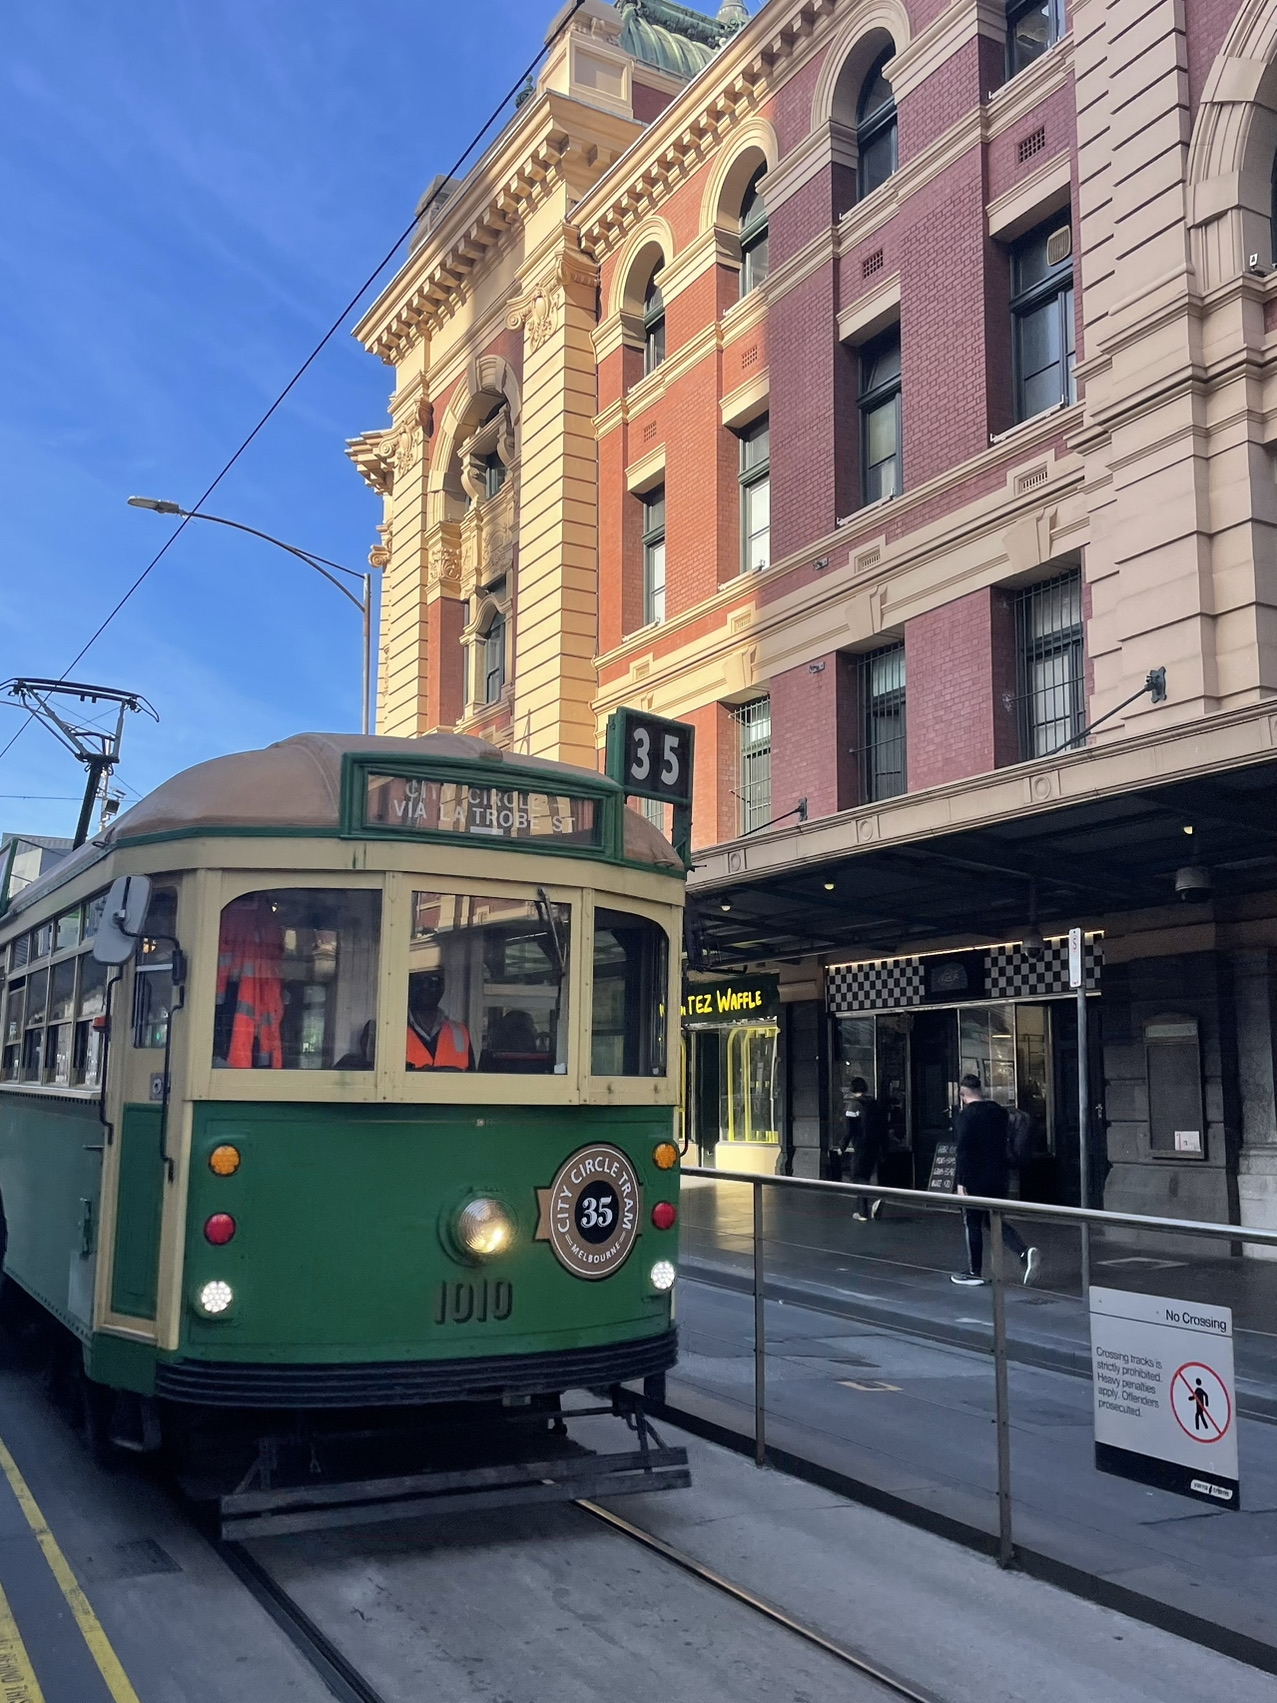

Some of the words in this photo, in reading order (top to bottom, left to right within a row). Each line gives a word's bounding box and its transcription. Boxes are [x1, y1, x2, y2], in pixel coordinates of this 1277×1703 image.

[393, 799, 427, 820] VIA
[440, 803, 465, 823] LA
[472, 807, 539, 830] TROBE
[552, 815, 576, 832] ST
[716, 987, 762, 1013] WAFFLE
[557, 1185, 573, 1233] CITY
[570, 1156, 620, 1185] CIRCLE
[617, 1171, 635, 1230] TRAM
[580, 1195, 613, 1229] 35
[570, 1241, 621, 1264] MELBOURNE
[434, 1279, 514, 1325] 1010
[1165, 1309, 1180, 1322] No
[1182, 1311, 1227, 1333] Crossing
[1096, 1346, 1129, 1364] Crossing
[1130, 1354, 1154, 1368] tracks
[1155, 1358, 1163, 1370] is
[1096, 1360, 1120, 1375] strictly
[1122, 1366, 1163, 1383] prohibited.
[1097, 1372, 1120, 1388] Heavy
[1122, 1379, 1156, 1394] penalties
[1098, 1386, 1120, 1400] apply.
[1121, 1390, 1159, 1408] Offenders
[1098, 1399, 1143, 1417] prosecuted.
